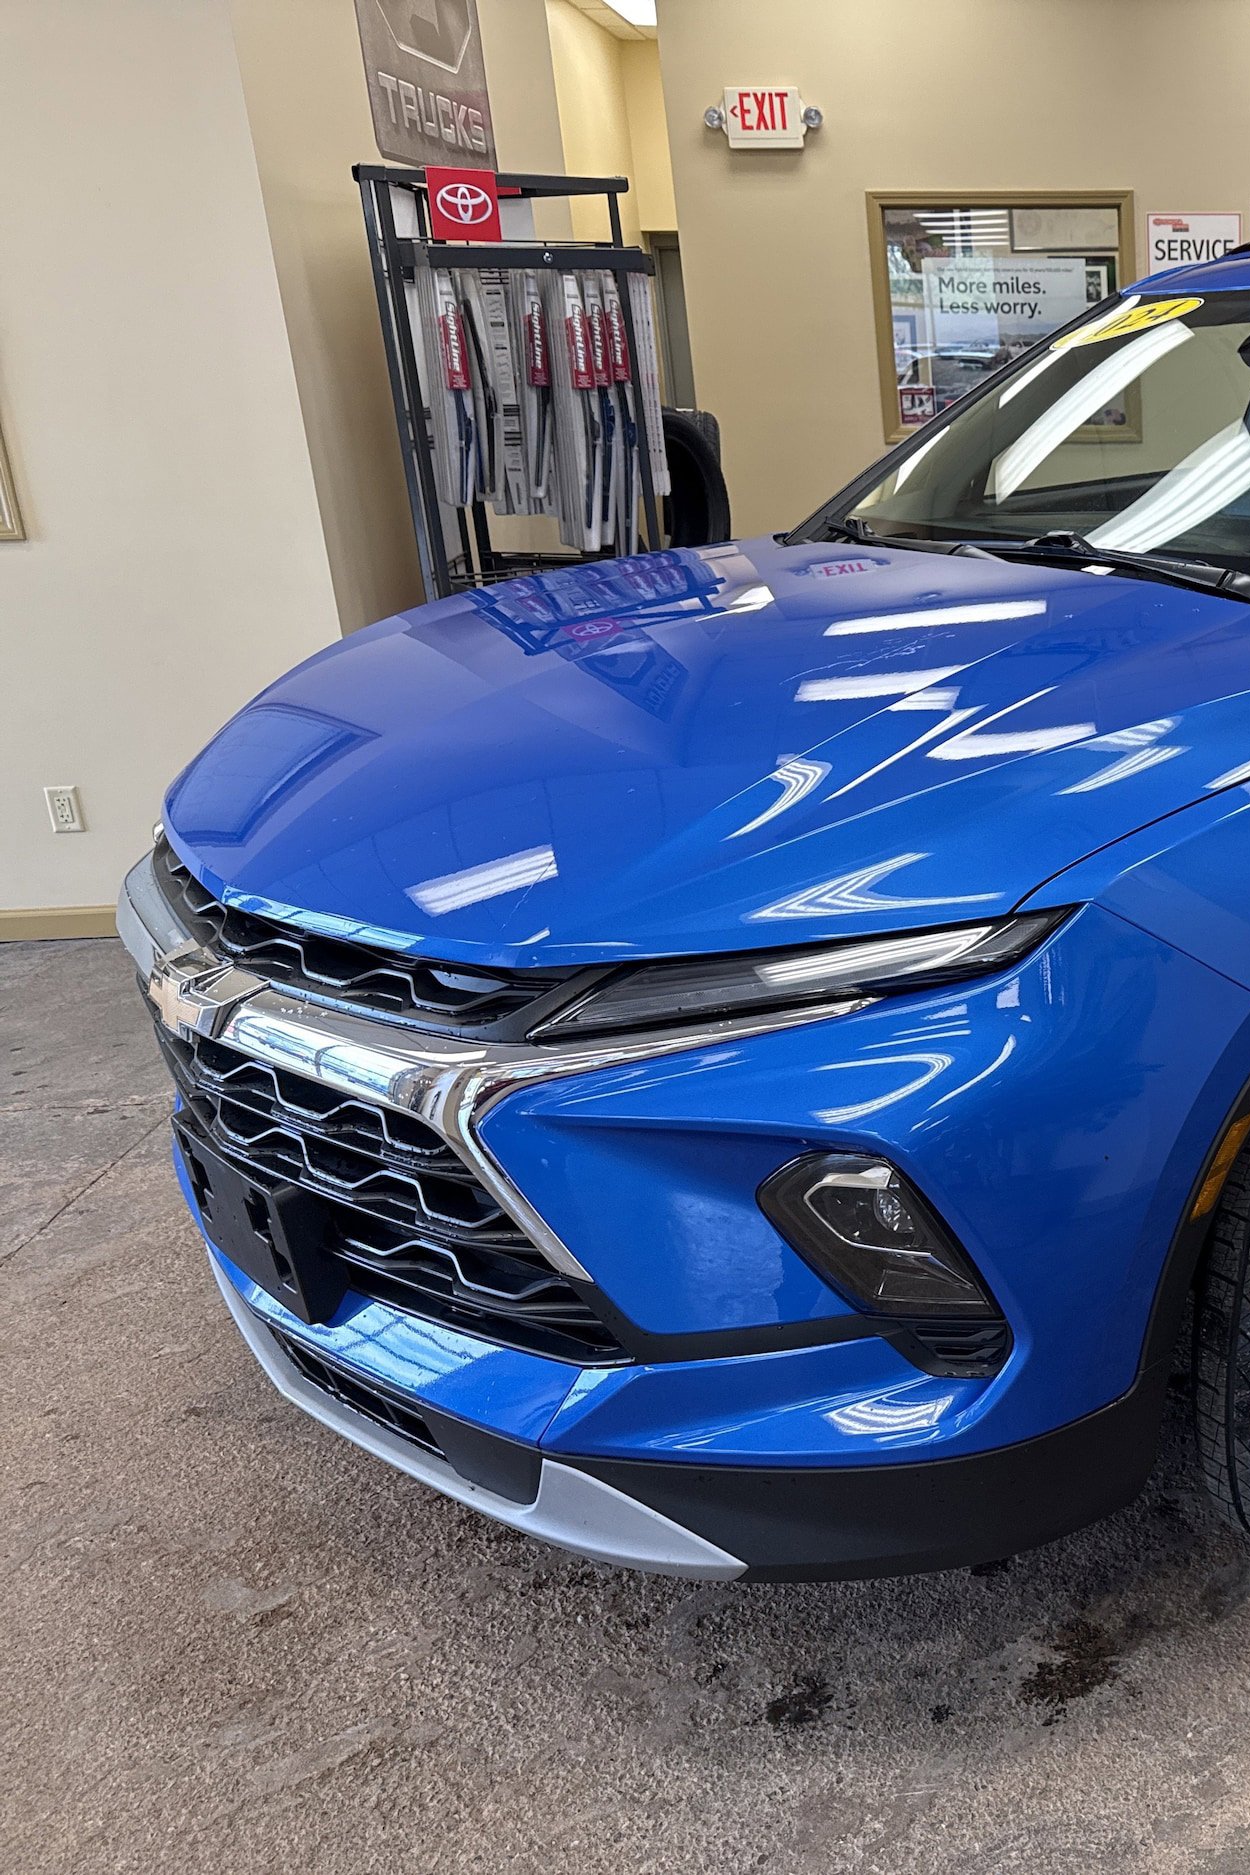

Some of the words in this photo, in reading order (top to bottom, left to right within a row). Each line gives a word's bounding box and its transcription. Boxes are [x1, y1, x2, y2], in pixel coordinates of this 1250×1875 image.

[378, 71, 487, 154] TRUCKS
[738, 92, 788, 131] EXIT
[1154, 239, 1235, 261] SERVICE
[938, 277, 987, 294] More
[992, 276, 1046, 295] miles.
[940, 298, 980, 314] Less
[984, 301, 1042, 319] worry.
